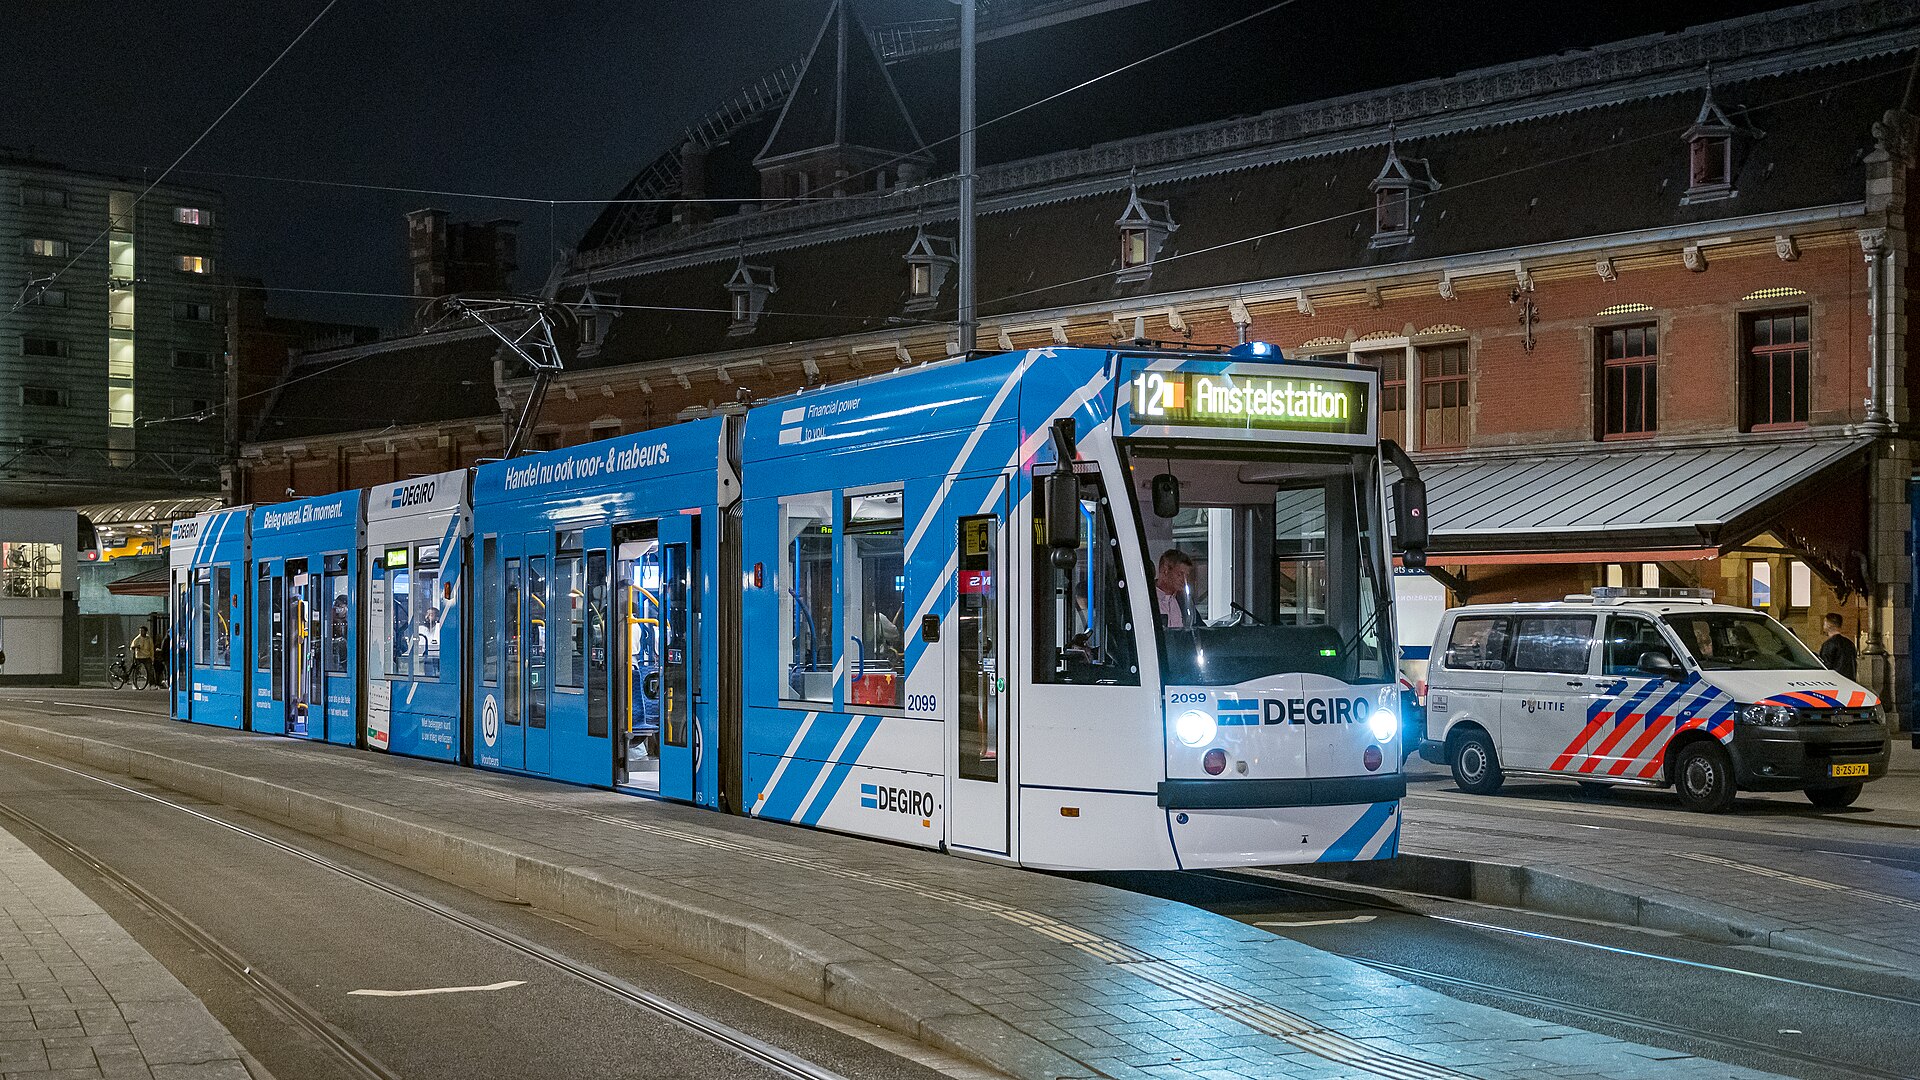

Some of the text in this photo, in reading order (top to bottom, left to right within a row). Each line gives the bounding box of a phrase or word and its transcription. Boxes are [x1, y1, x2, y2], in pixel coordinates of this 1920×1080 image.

[1133, 372, 1348, 419] 12 Amstelstation
[807, 398, 861, 418] Financial power
[805, 427, 812, 441] to
[504, 442, 670, 491] Handel nu ook voor- & nabeurs.
[401, 481, 435, 507] DEGIRO
[263, 500, 343, 530] Beleg overal. Elk moment.
[178, 522, 199, 540] DEGIRO
[907, 694, 937, 712] 2099
[1170, 692, 1207, 704] 2099
[1263, 696, 1370, 726] DEGIRO
[1835, 766, 1866, 775] 8-ZSJ-74
[878, 785, 934, 818] DEGIRO
